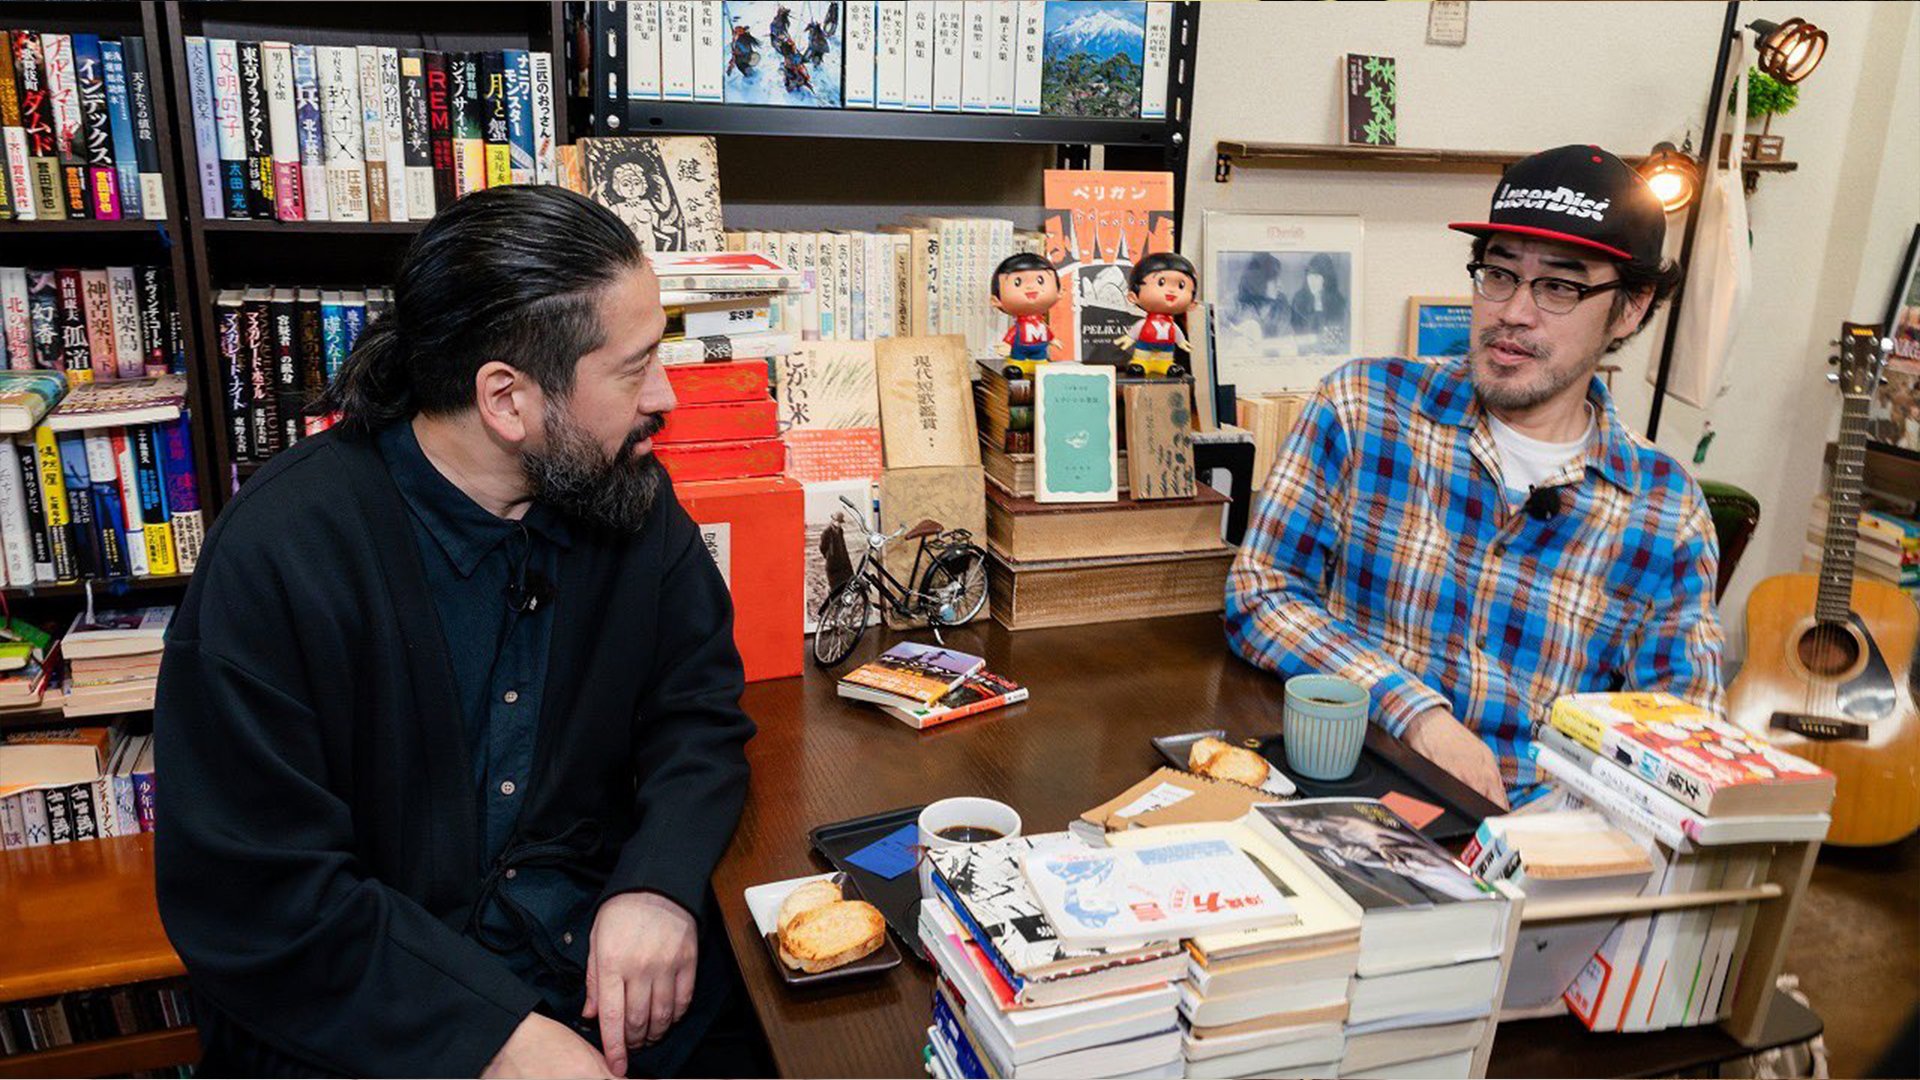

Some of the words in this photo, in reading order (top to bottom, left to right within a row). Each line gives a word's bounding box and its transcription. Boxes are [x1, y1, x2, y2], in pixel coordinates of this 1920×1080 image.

[79, 58, 113, 165] インデックス
[216, 48, 240, 139] 文明の子
[242, 46, 265, 152] 東京ブラックアウト
[428, 70, 450, 131] REM
[451, 60, 469, 140] ジェノサイド
[486, 72, 509, 143] 月と蟹
[504, 68, 522, 137] モンスター
[535, 57, 552, 140] 三匹のおっさん
[228, 163, 247, 209] 太田光
[677, 157, 706, 184] 鍵
[1071, 185, 1147, 200] ペリカン
[32, 302, 58, 346] 幻香
[62, 324, 89, 370] 孤道
[246, 311, 267, 400] マスカレード・ホテル
[1025, 323, 1048, 343] M
[1150, 319, 1173, 341] Y
[224, 313, 247, 410] マスカレード・ナイト
[784, 350, 812, 426] にがい米
